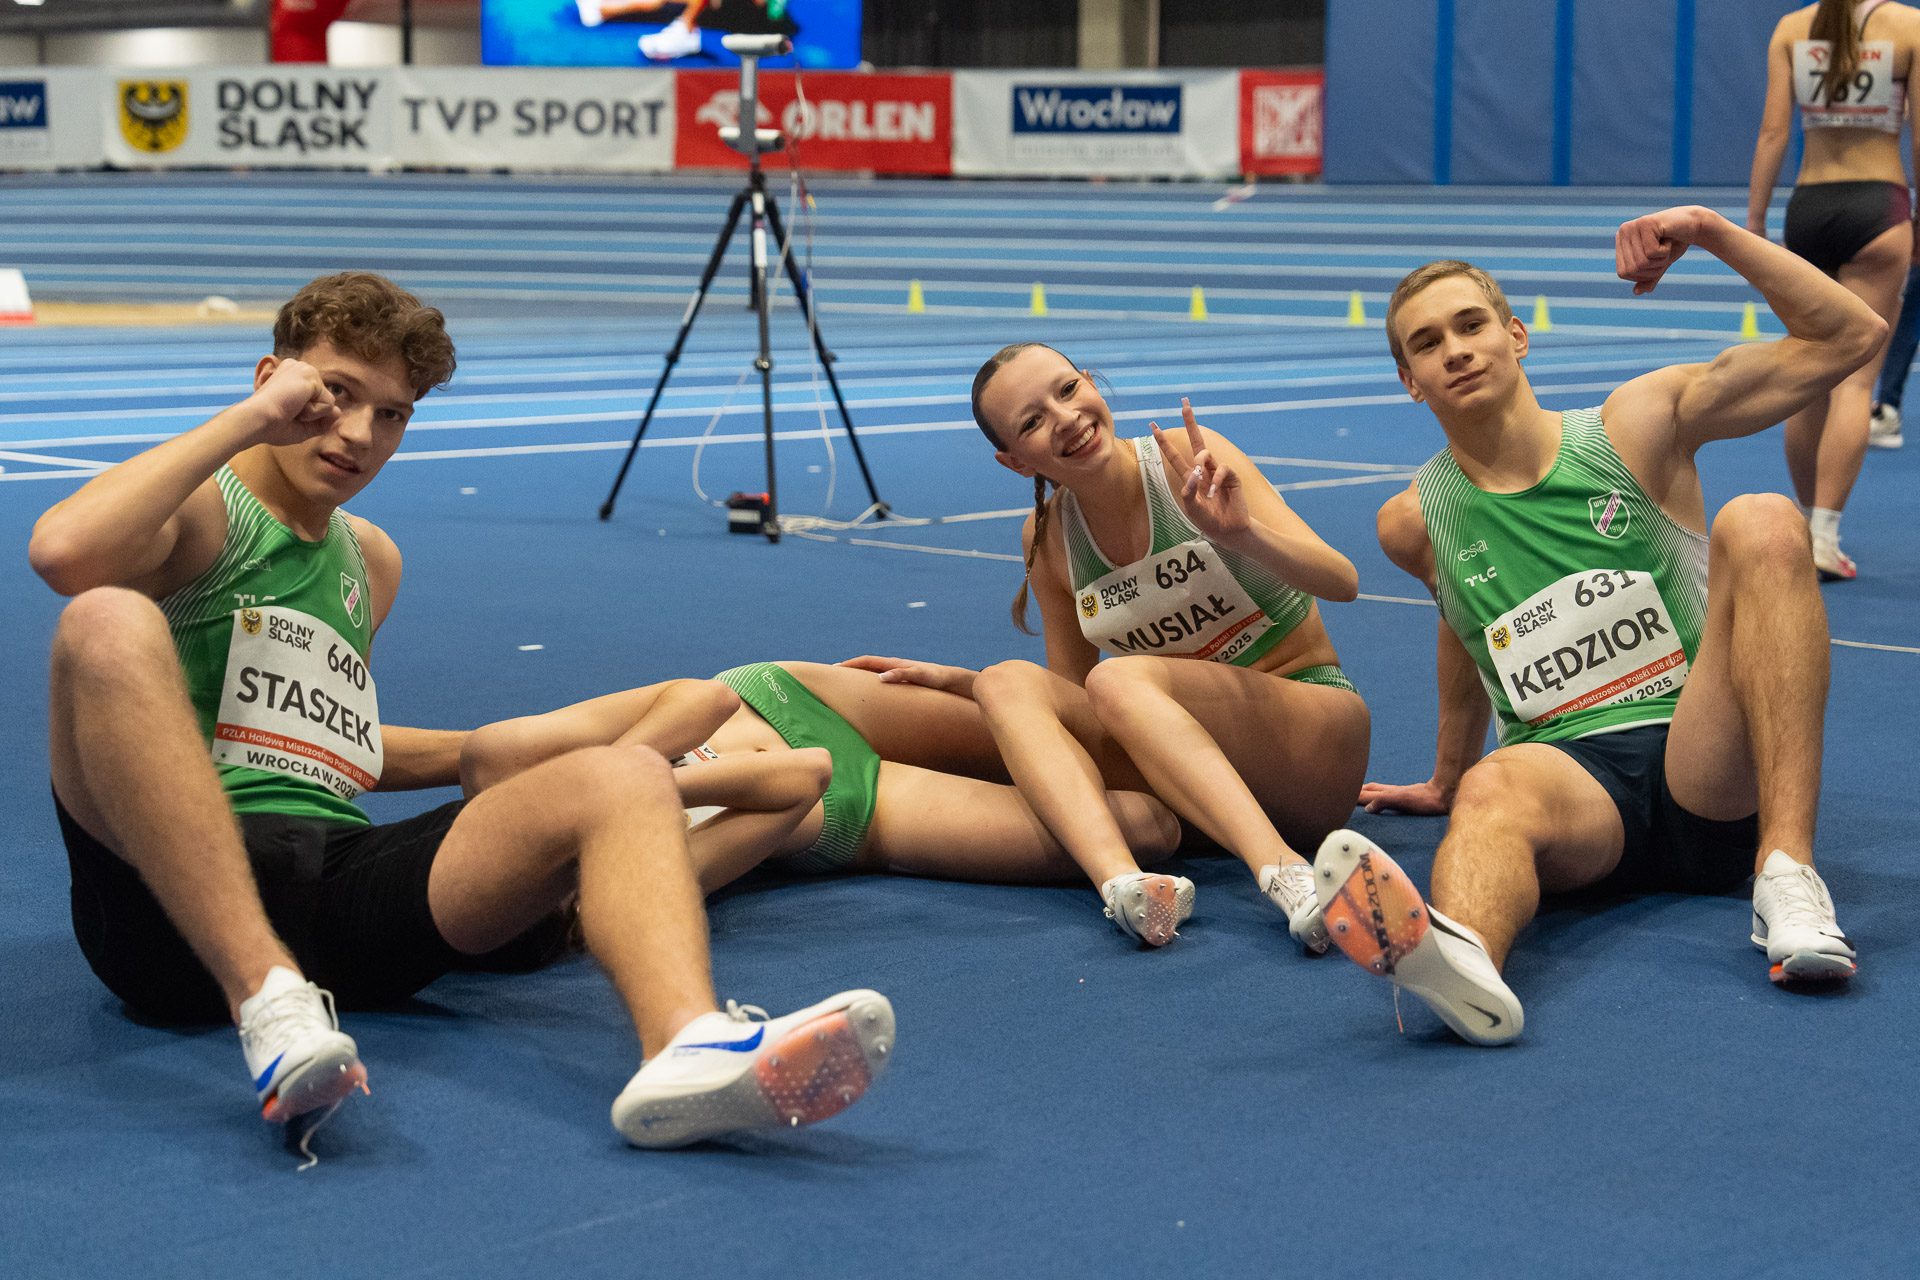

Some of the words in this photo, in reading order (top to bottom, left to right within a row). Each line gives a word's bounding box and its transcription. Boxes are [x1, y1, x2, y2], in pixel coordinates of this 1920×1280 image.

[217, 80, 376, 111] DOLNY
[219, 111, 368, 153] ŚLĄSK
[403, 98, 498, 136] TVP
[513, 98, 664, 136] SPORT
[782, 100, 935, 142] ORLEN
[1100, 575, 1138, 599] DOLNY
[1155, 549, 1207, 590] 634
[1574, 570, 1636, 608] 631
[270, 615, 315, 640] DOLNY
[1108, 594, 1236, 653] MUSIAŁ
[1513, 598, 1553, 628] DOLNY
[1209, 633, 1231, 651] Polski
[1221, 632, 1252, 660] 2025
[1510, 607, 1669, 702] KĘDZIOR
[327, 643, 366, 692] 640
[1578, 682, 1626, 708] Mistrzostwa
[1626, 669, 1651, 685] Polski
[1650, 661, 1665, 674] U18
[1636, 676, 1673, 701] 2025
[236, 666, 375, 754] STASZEK
[248, 732, 284, 748] Halowe
[286, 741, 334, 764] Mistrzostwa
[247, 750, 333, 784] WROCŁAW
[334, 776, 357, 800] 2025
